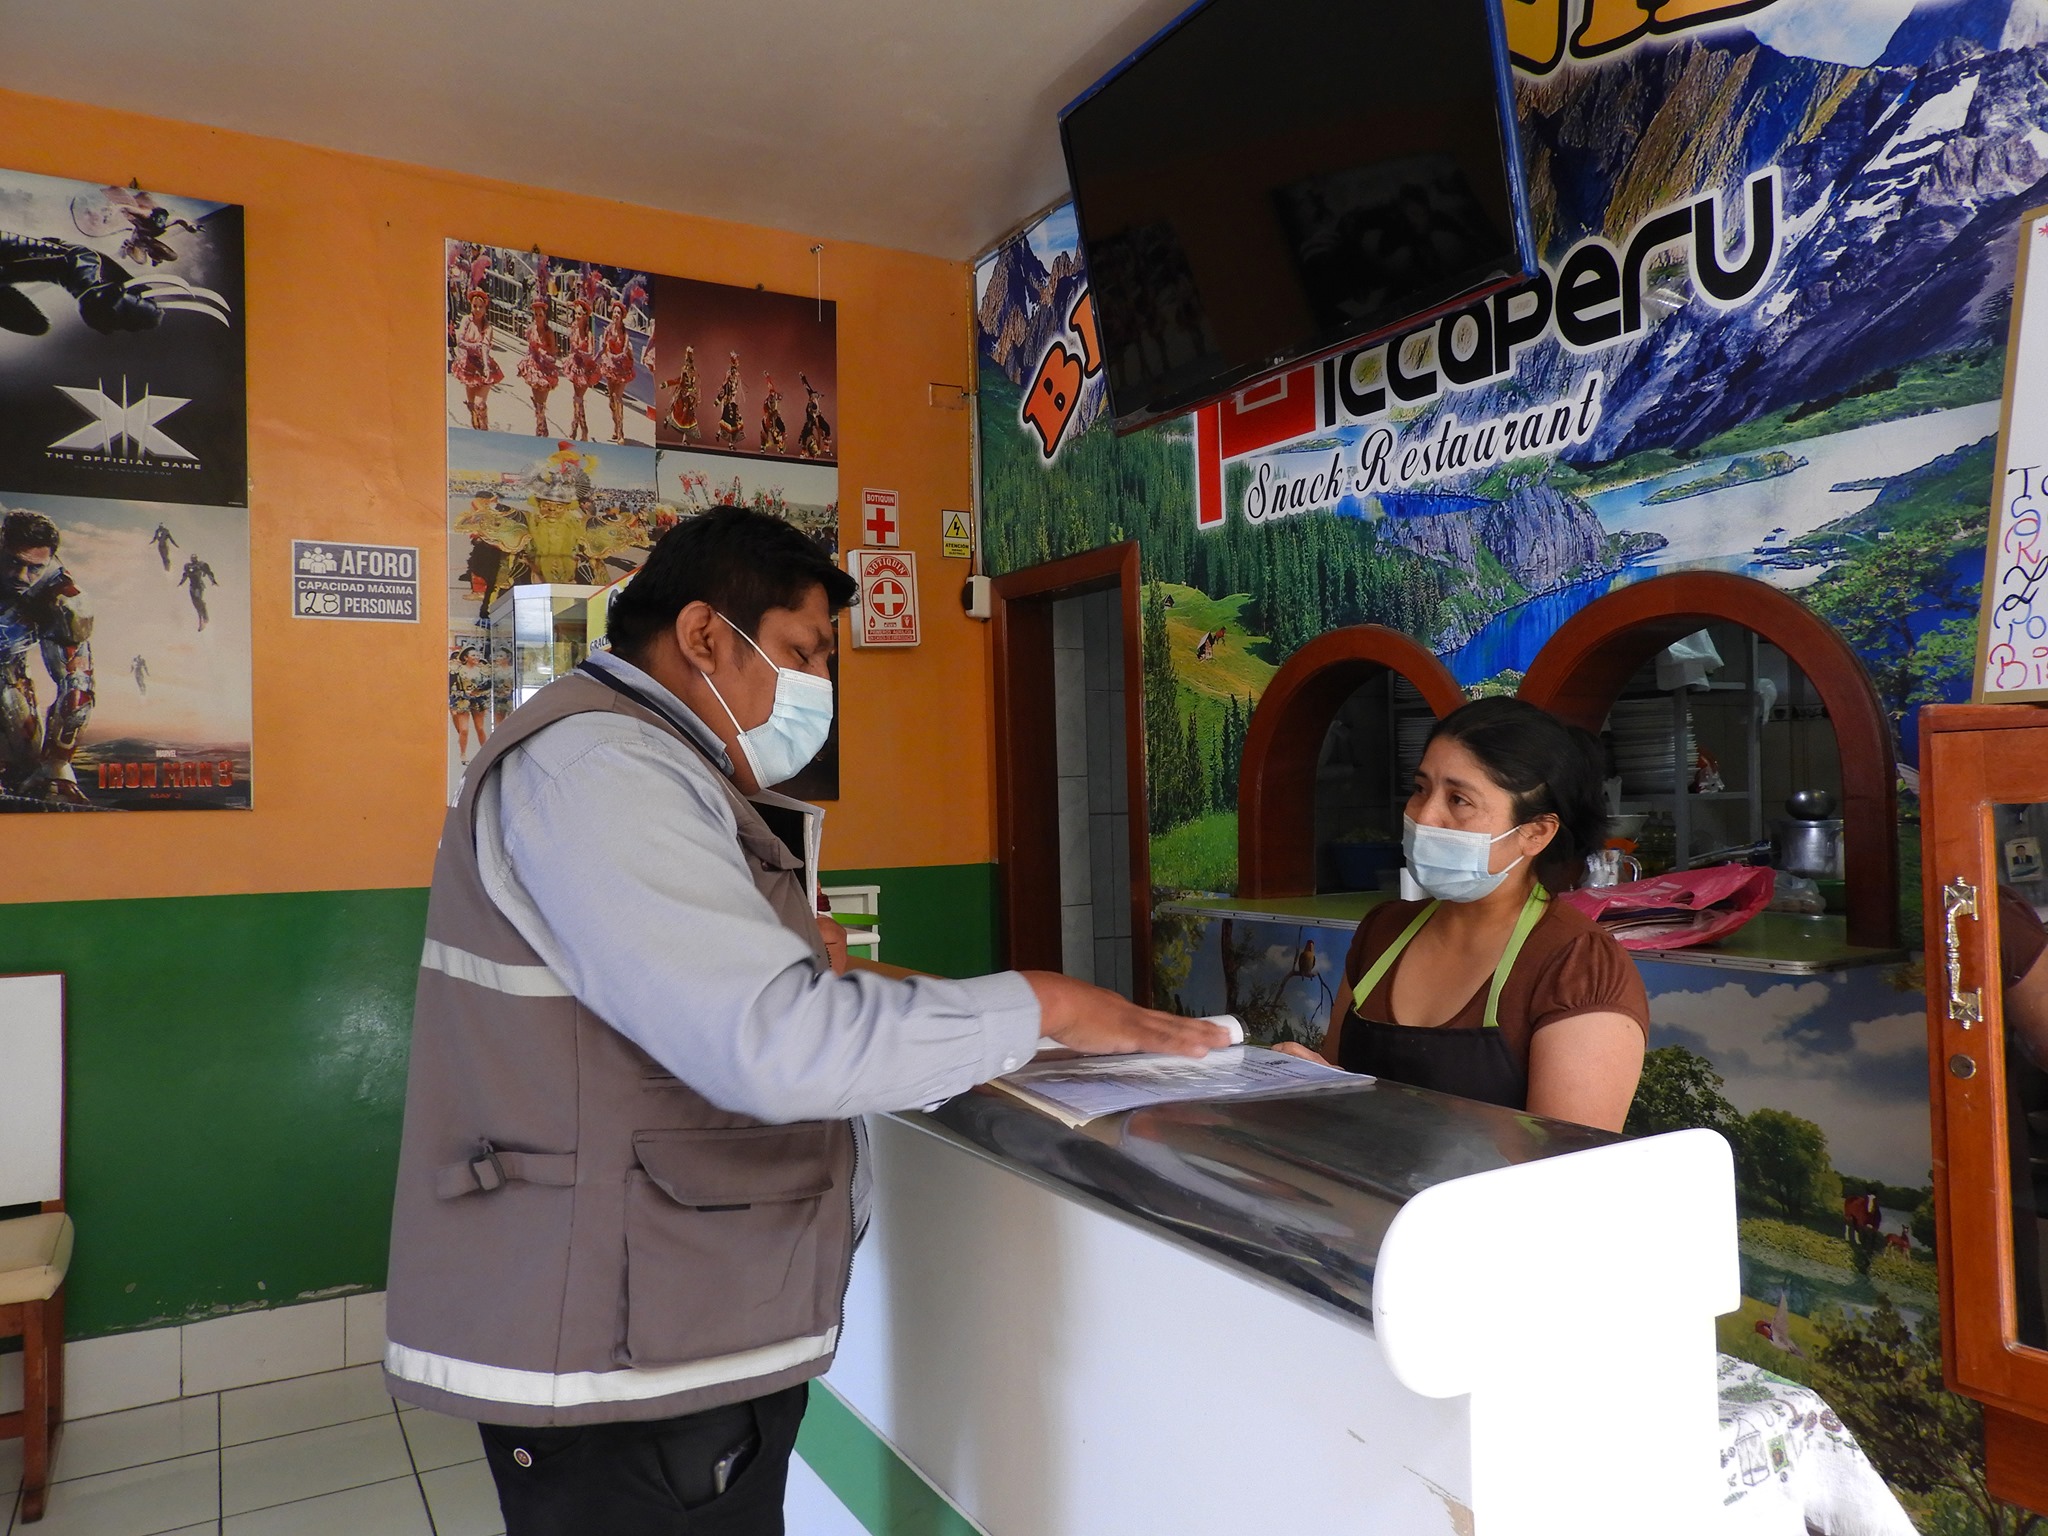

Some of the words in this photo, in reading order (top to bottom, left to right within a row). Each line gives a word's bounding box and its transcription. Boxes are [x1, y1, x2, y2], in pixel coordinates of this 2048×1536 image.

[1248, 453, 1342, 519] Snack
[1355, 379, 1598, 492] Restaurant
[45, 452, 74, 461] THE
[83, 455, 153, 466] OFFICIAL
[161, 461, 202, 470] GAME
[866, 493, 895, 504] BOTIQUIN
[340, 549, 413, 578] AFORO
[868, 558, 906, 575] BOTIQUIN
[298, 580, 365, 593] CAPACIDAD
[367, 583, 413, 595] MÁXIMA
[304, 591, 339, 614] 28
[344, 597, 413, 616] PERSONAS
[155, 749, 177, 758] MARVEL
[98, 762, 157, 789] IRON
[163, 762, 213, 788] MAN
[218, 759, 234, 788] 3
